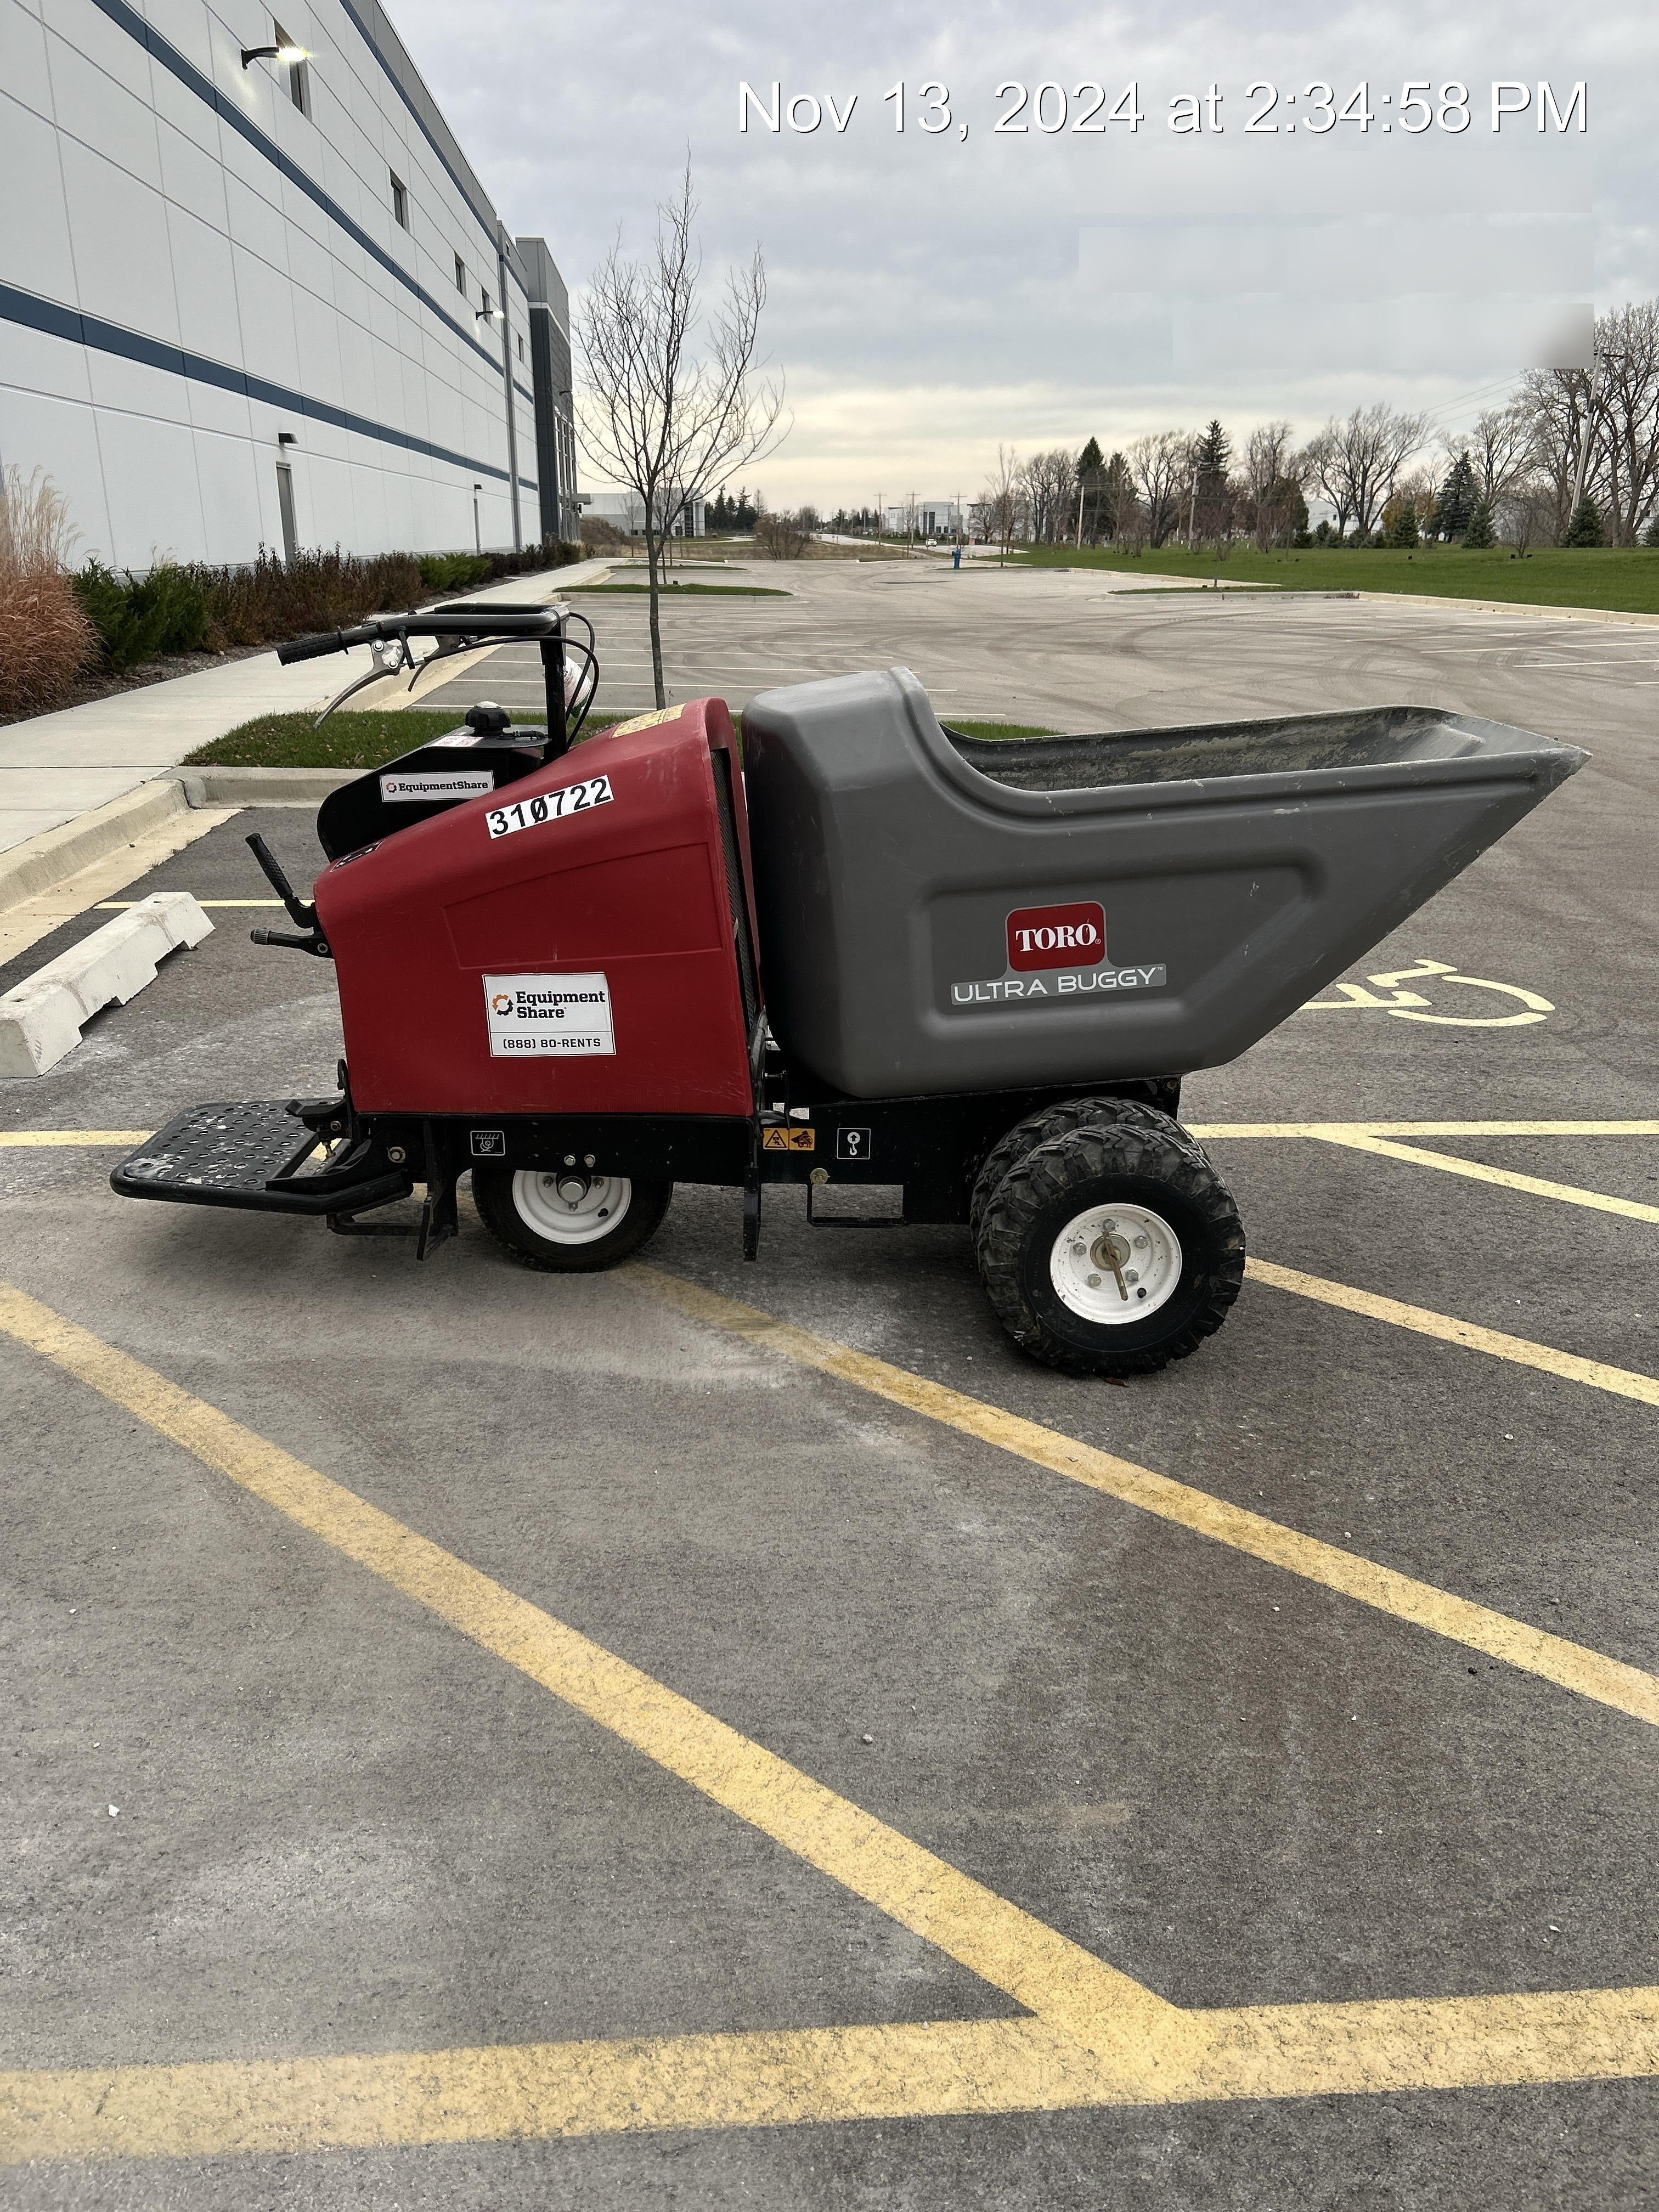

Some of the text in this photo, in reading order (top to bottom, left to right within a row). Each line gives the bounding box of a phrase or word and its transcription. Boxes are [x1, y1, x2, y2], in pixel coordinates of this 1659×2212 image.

[398, 781, 488, 793] EquipmentShare
[489, 777, 612, 836] 310722
[516, 990, 606, 1007] Equipment
[953, 979, 1048, 1003] ULTRA
[517, 1006, 565, 1019] Share
[503, 1037, 601, 1049] (888) 80-RENTS
